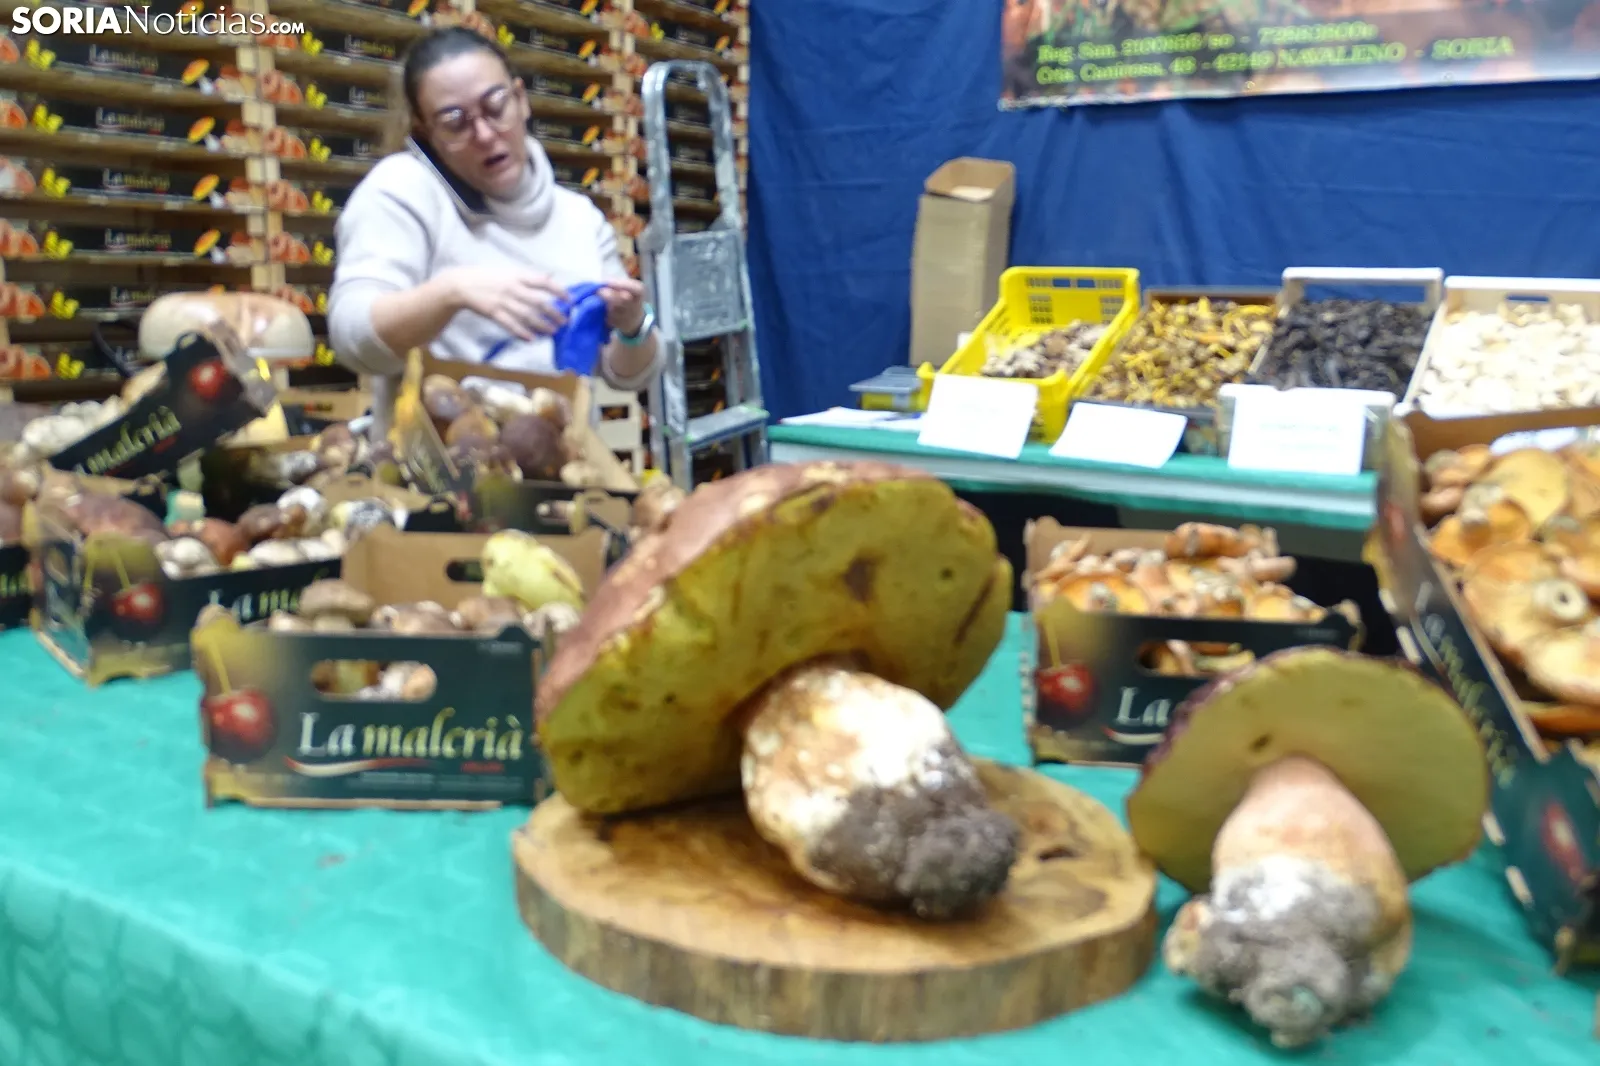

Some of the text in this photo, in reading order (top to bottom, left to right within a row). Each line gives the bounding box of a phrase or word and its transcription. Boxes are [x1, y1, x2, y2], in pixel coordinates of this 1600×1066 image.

[1277, 41, 1406, 68] NAVALENO
[1431, 36, 1515, 61] SORIA
[1116, 686, 1172, 728] La
[298, 711, 356, 757] La
